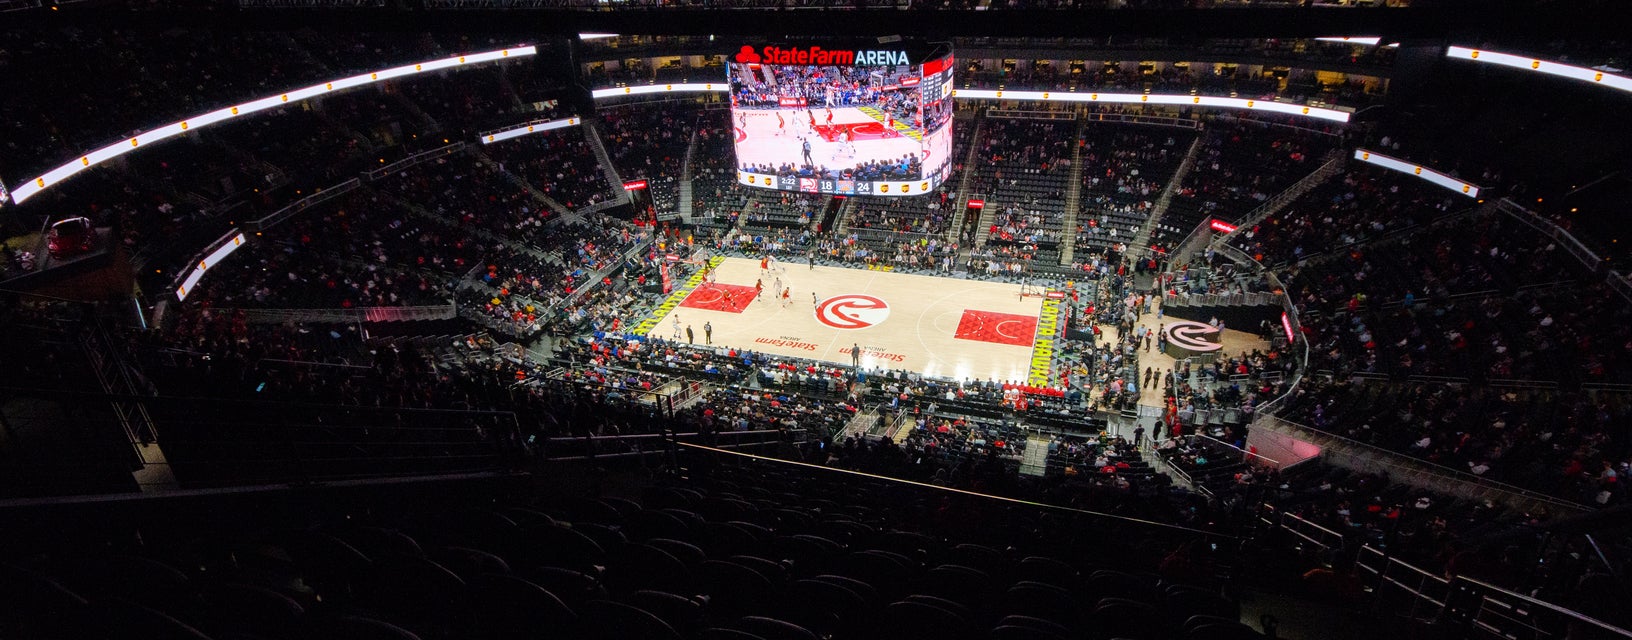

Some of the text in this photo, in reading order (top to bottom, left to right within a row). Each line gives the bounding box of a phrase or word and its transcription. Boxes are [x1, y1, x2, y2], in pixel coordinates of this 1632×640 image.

[854, 50, 910, 65] ARENA
[781, 177, 796, 185] 2:22
[821, 181, 832, 190] 18
[857, 182, 870, 192] 24
[632, 290, 690, 336] ATLANTA
[1028, 339, 1054, 389] HAWKS
